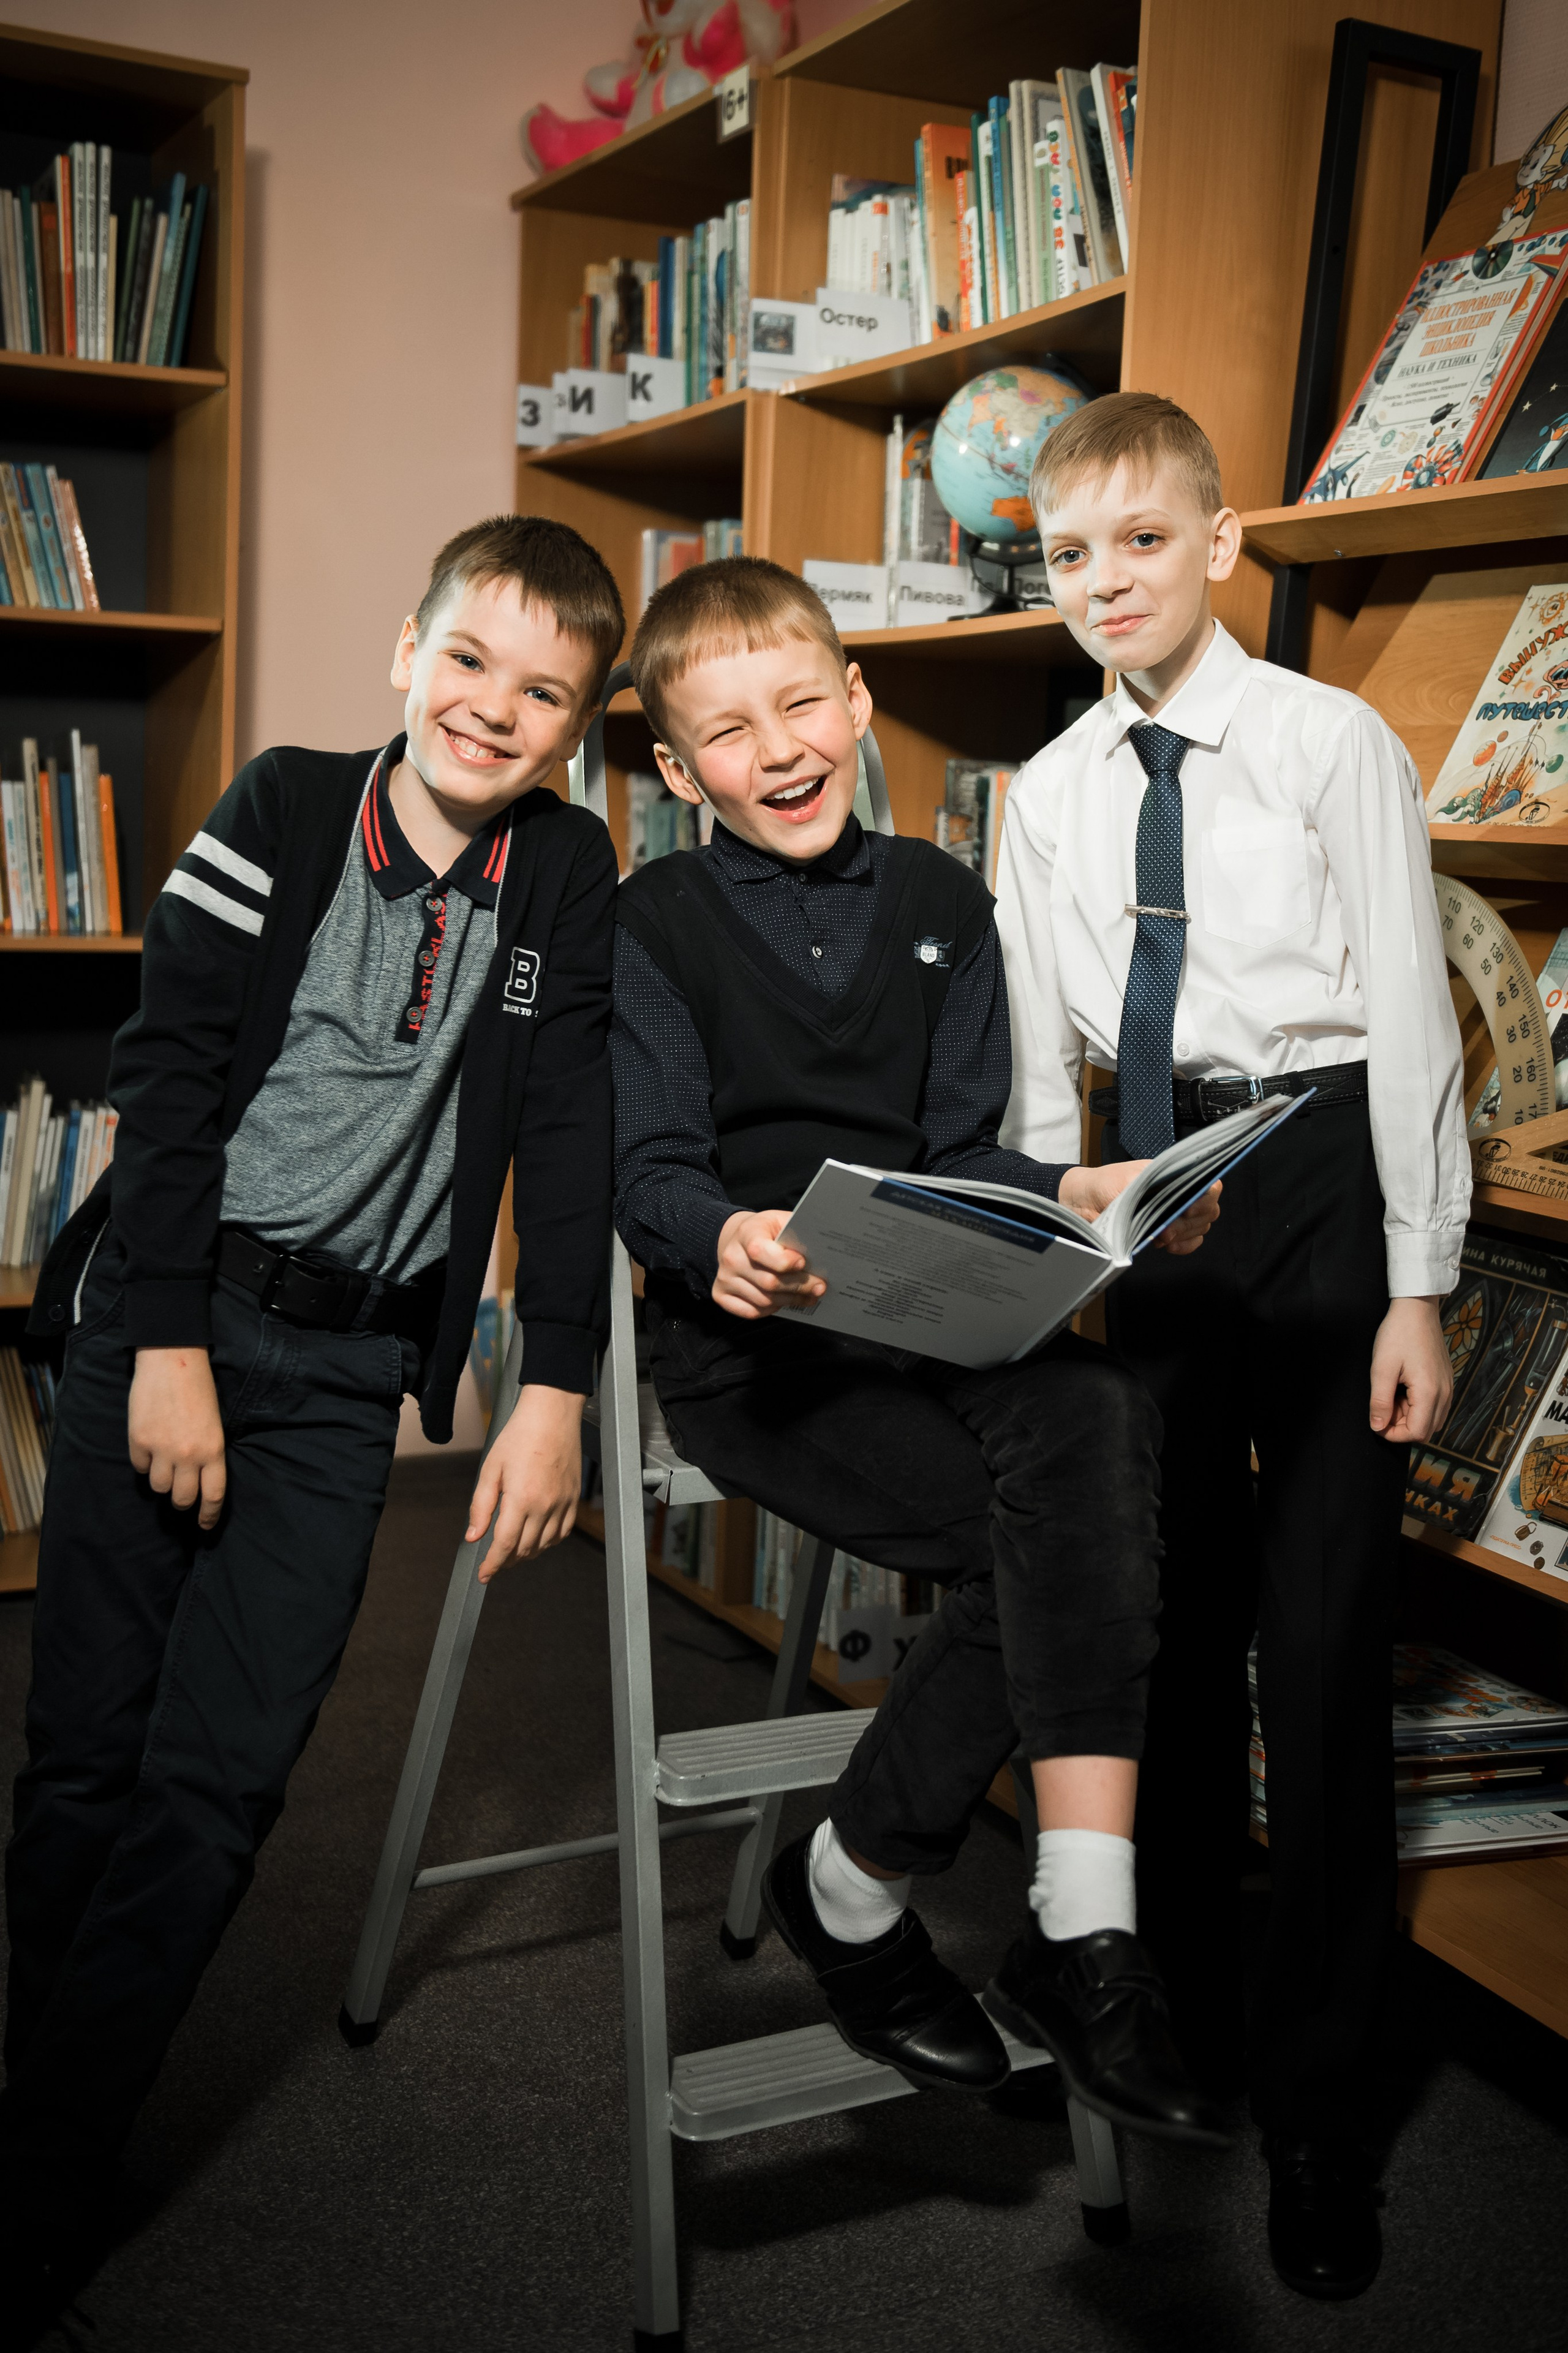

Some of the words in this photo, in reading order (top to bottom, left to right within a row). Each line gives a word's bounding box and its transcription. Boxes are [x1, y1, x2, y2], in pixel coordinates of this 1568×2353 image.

[820, 308, 879, 332] Остер
[1397, 364, 1427, 378] НАУКА
[1427, 361, 1436, 372] И
[1436, 353, 1478, 371] ТЕХНИКА
[630, 371, 653, 402] К
[569, 385, 594, 415] И
[1447, 897, 1461, 913] 110
[1442, 915, 1453, 931] 70
[1470, 916, 1484, 935] 120
[1463, 934, 1474, 950] 60
[1490, 942, 1504, 964] 130
[504, 946, 540, 1003] B
[1480, 958, 1491, 975] 50
[1506, 975, 1519, 999] 140
[1496, 991, 1506, 1007] 40
[520, 1007, 532, 1017] TO
[1506, 1025, 1517, 1043] 30
[1518, 1014, 1530, 1039] 150
[1513, 1065, 1522, 1083] 20
[1526, 1057, 1536, 1082] 160
[1514, 1109, 1523, 1125] 10
[1528, 1103, 1537, 1119] 17
[1502, 1166, 1511, 1175] 30
[1491, 1254, 1547, 1278] КУРЯЧАЯ
